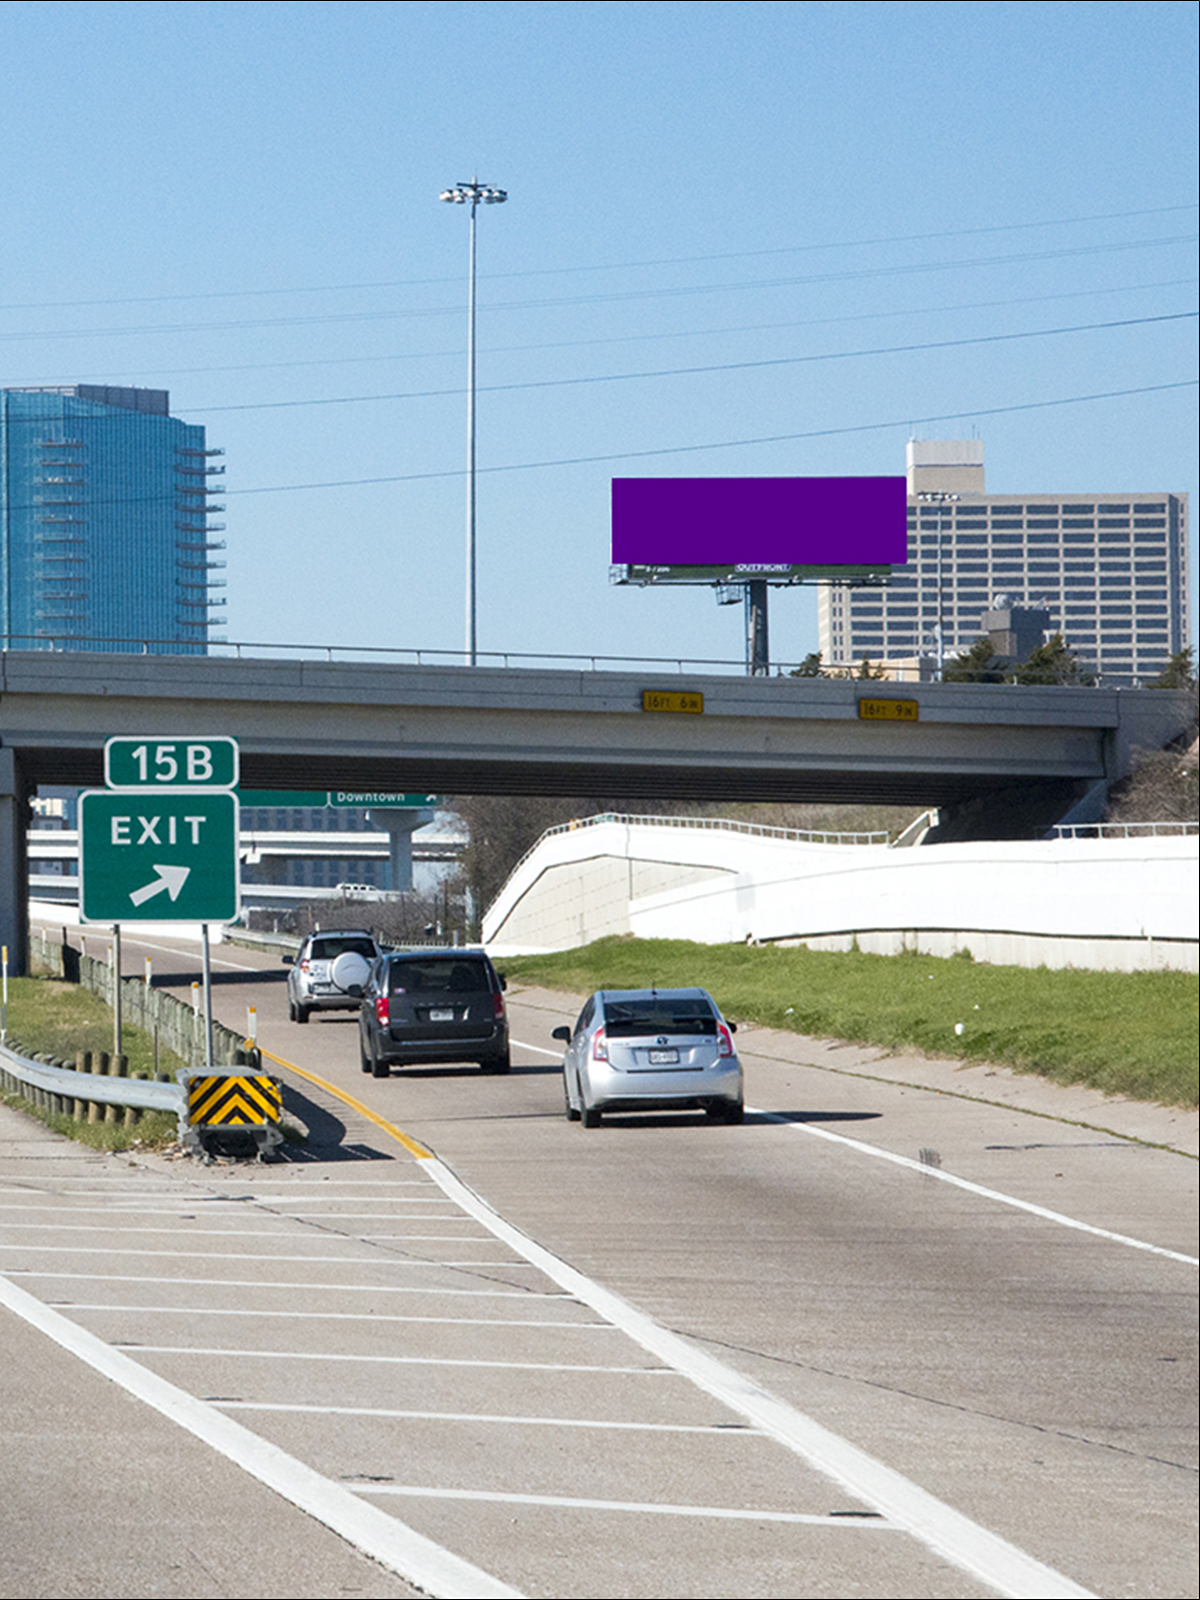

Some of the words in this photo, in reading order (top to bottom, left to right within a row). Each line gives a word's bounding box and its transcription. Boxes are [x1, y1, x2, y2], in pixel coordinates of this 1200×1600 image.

[131, 745, 213, 781] 15B
[337, 792, 405, 802] Downtown
[111, 816, 207, 845] EXIT
